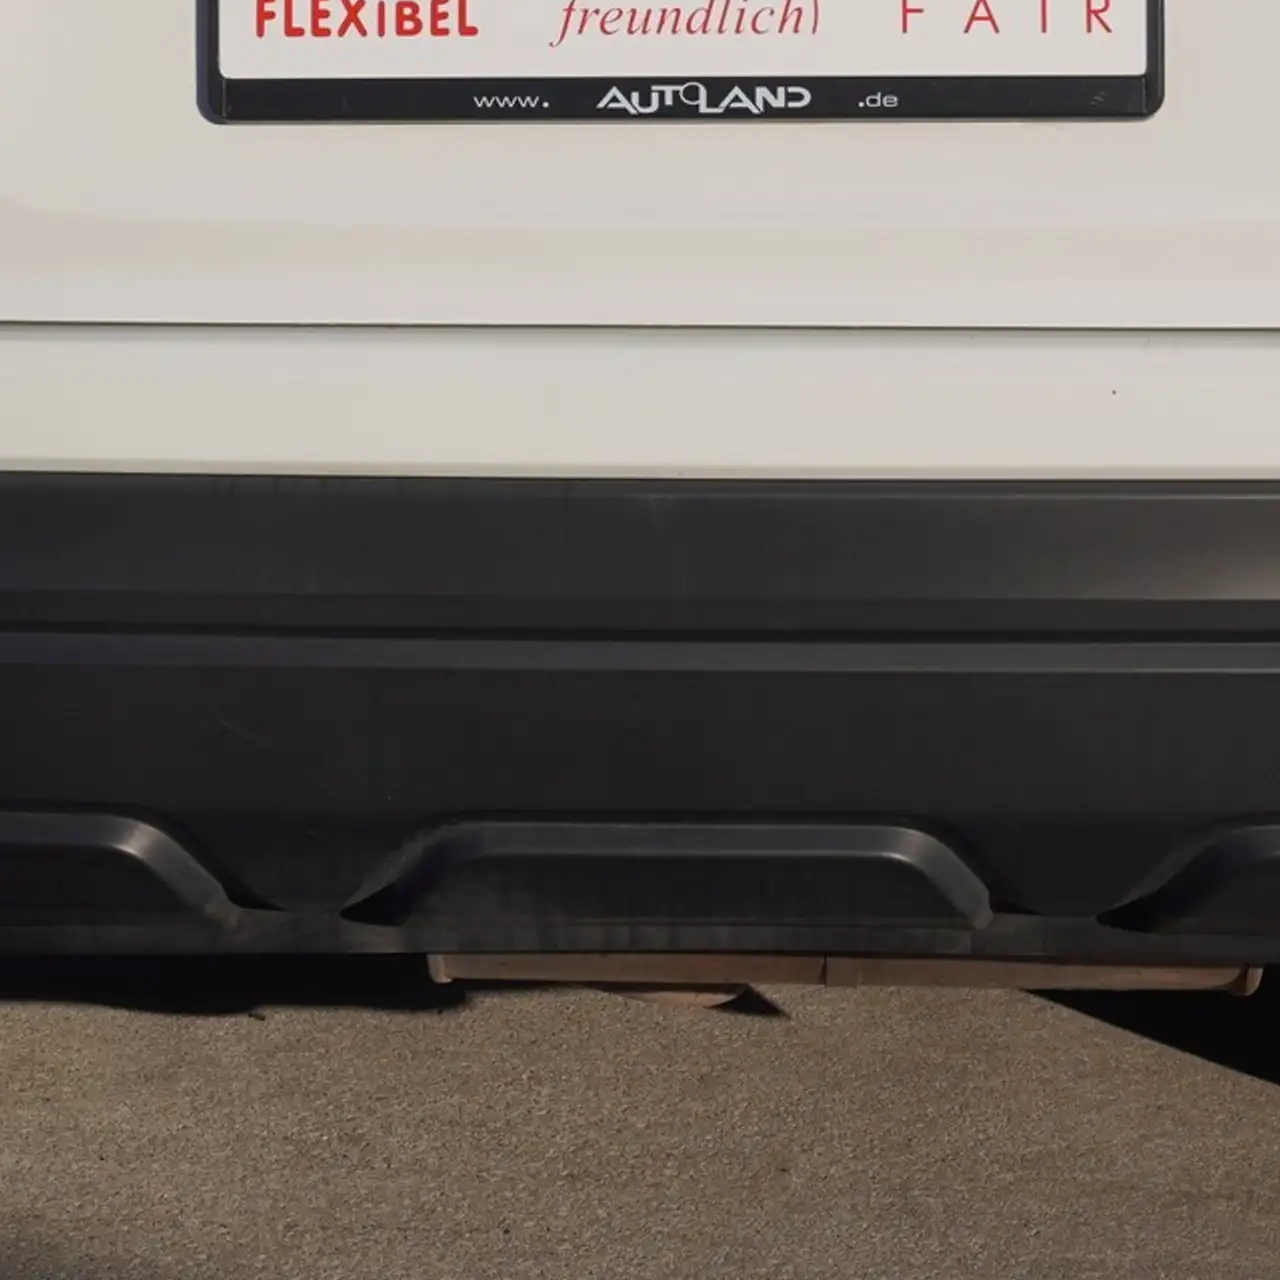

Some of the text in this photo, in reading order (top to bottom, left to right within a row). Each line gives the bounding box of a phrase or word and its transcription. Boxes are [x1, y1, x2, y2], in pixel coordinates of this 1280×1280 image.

[473, 82, 898, 115] www. AUTOLAND .de
